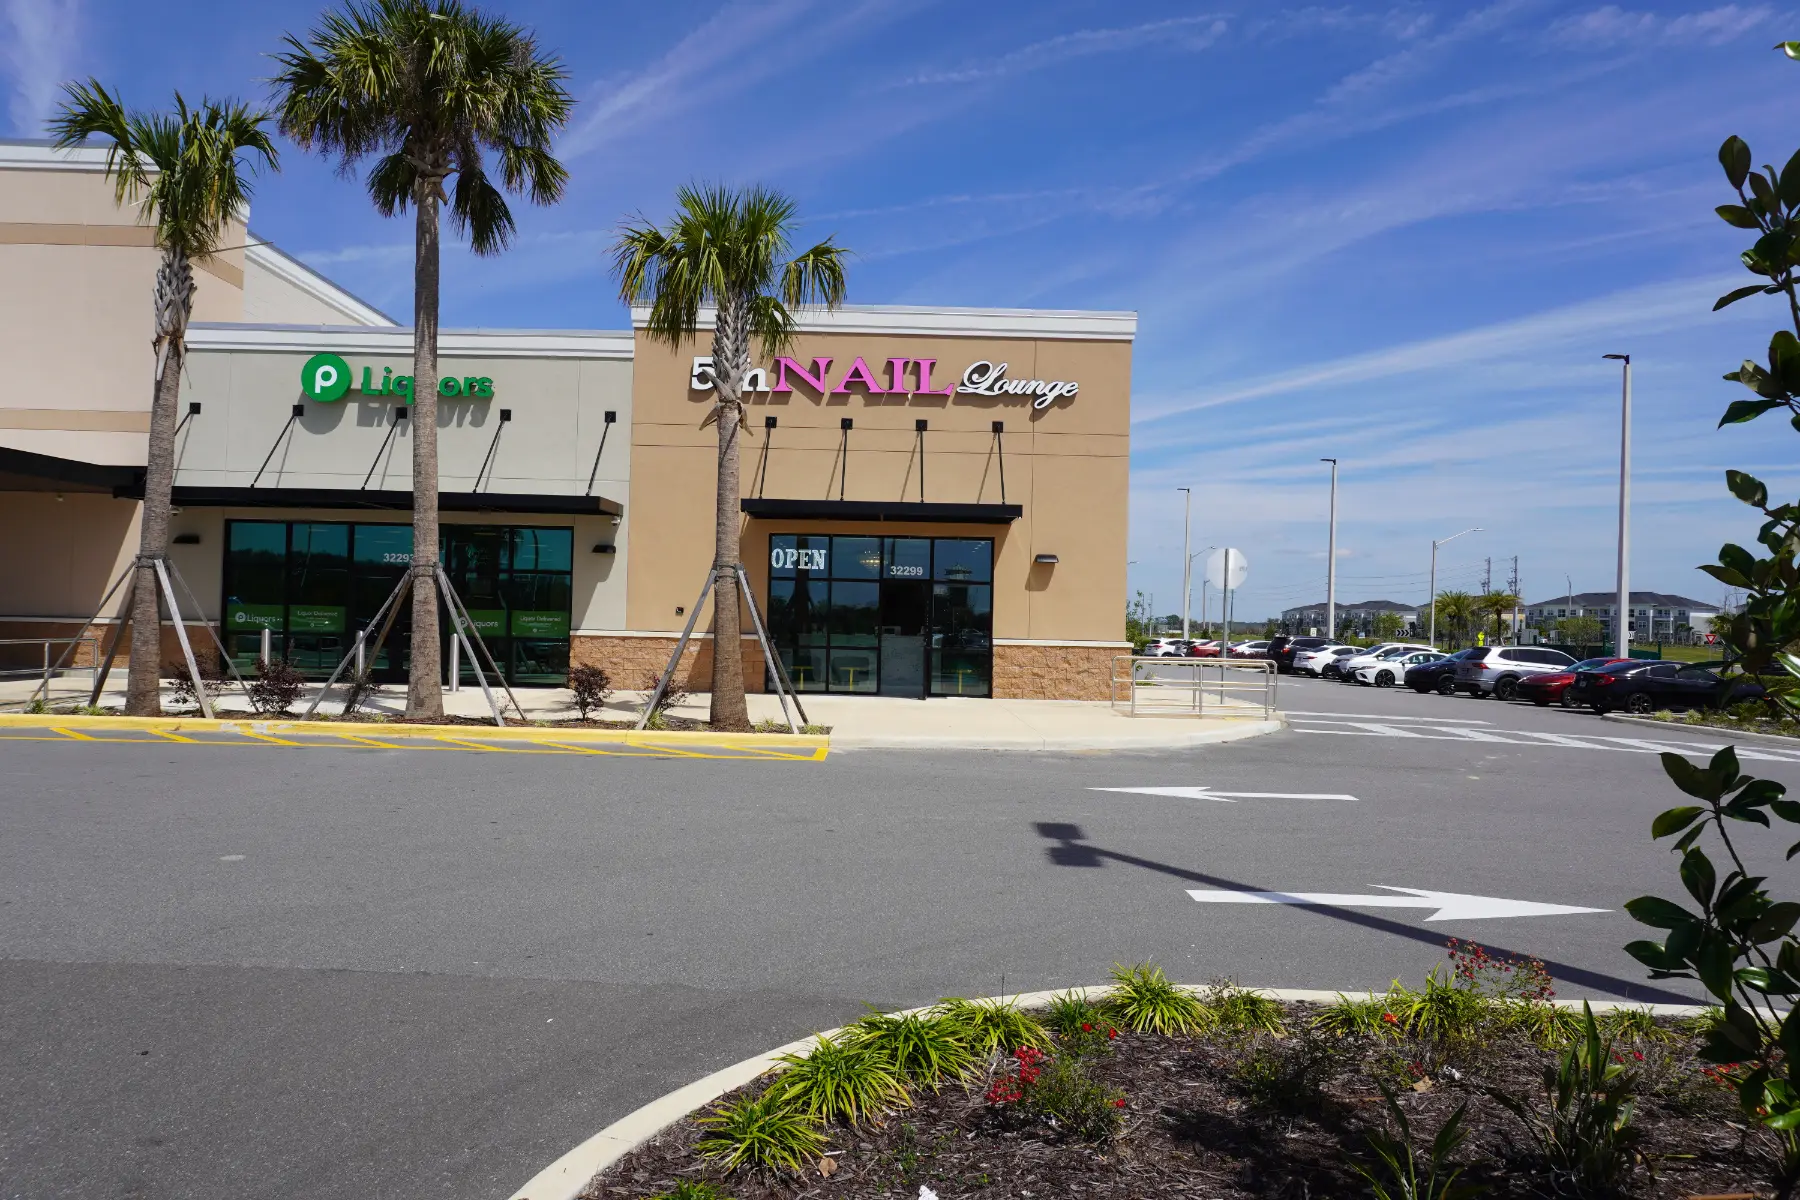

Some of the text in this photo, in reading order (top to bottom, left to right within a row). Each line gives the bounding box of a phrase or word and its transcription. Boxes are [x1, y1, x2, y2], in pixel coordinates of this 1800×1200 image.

[361, 366, 494, 405] Liqors
[772, 356, 955, 396] NAIL
[957, 360, 1079, 409] Lounge
[771, 548, 827, 570] OPEN
[890, 565, 923, 577] 32299
[246, 611, 276, 624] Liquors
[473, 619, 499, 629] iquors
